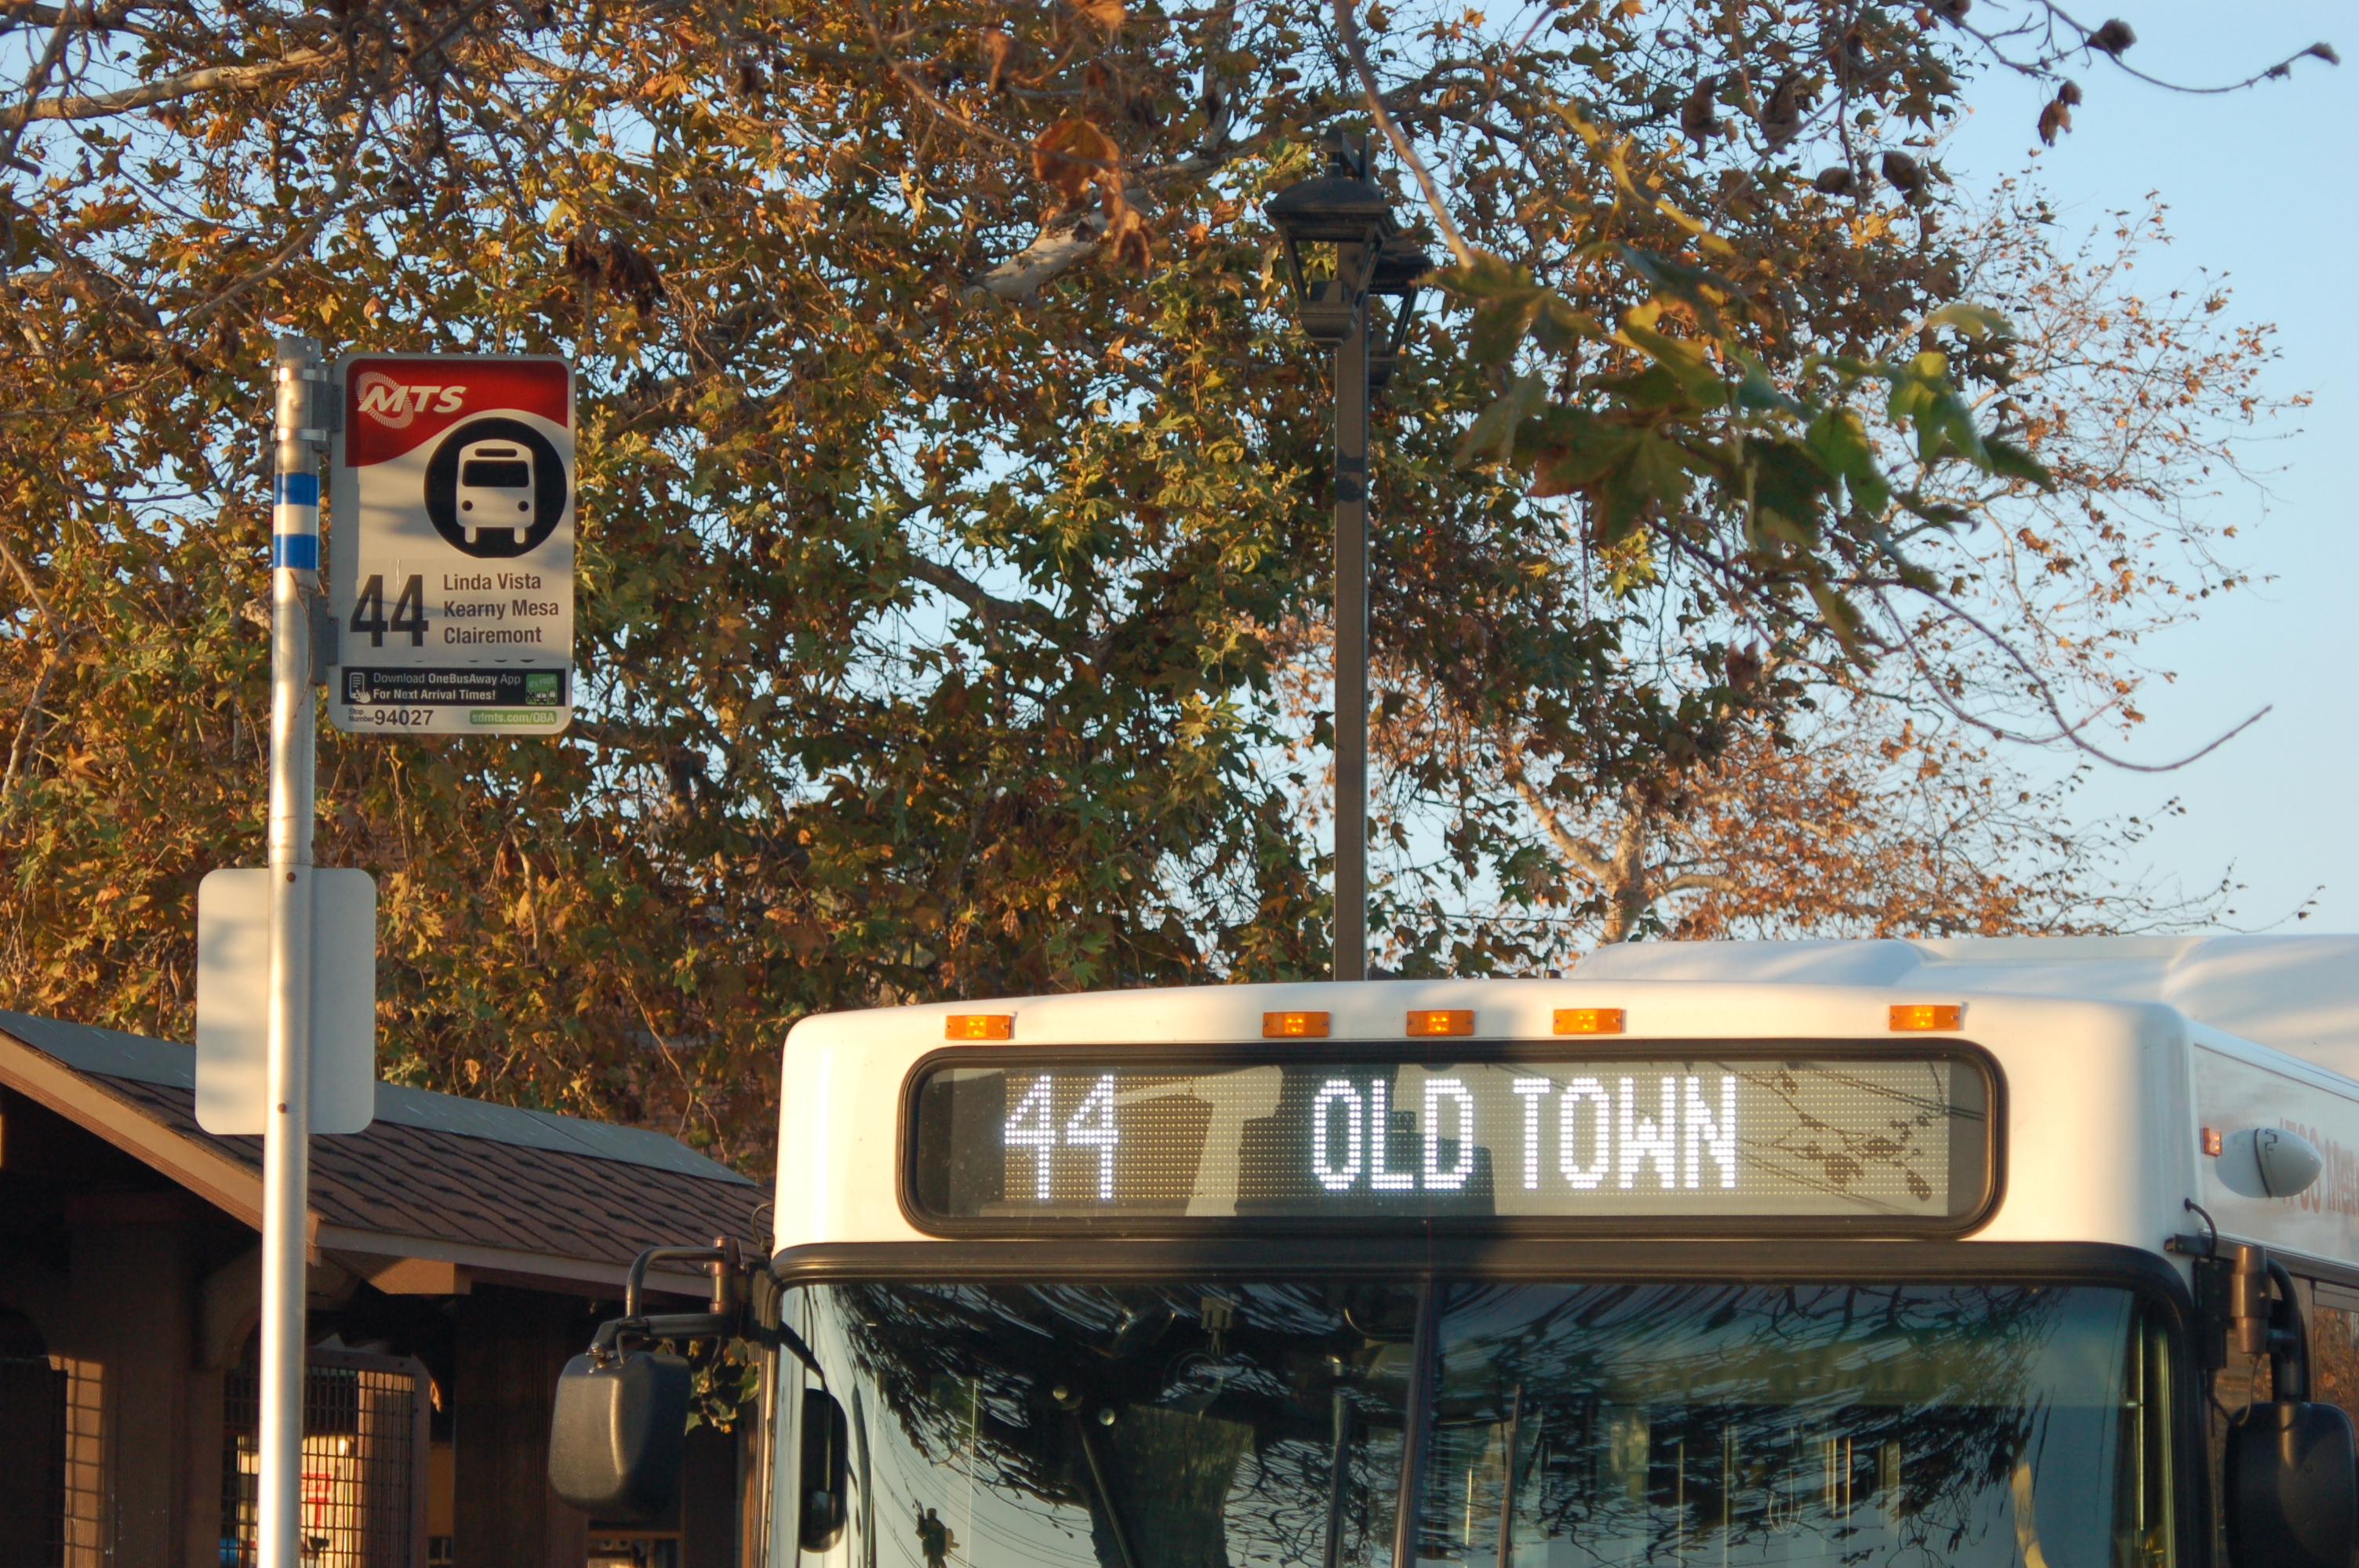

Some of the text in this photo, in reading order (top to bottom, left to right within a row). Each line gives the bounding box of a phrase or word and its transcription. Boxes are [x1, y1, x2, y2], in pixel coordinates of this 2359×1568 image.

[358, 385, 467, 413] MTS
[443, 573, 541, 591] Linda Vista
[350, 574, 429, 648] 44
[443, 599, 559, 620] Kearny Mesa
[443, 626, 542, 644] Clairemont
[373, 673, 521, 685] Download OneBusAway App
[540, 677, 555, 685] FREE
[373, 688, 496, 700] For Next Arrival Times!
[374, 709, 434, 726] 94027
[472, 712, 555, 723] sdmts.com/OBA
[1004, 1075, 1736, 1200] 44 OLD TOWN
